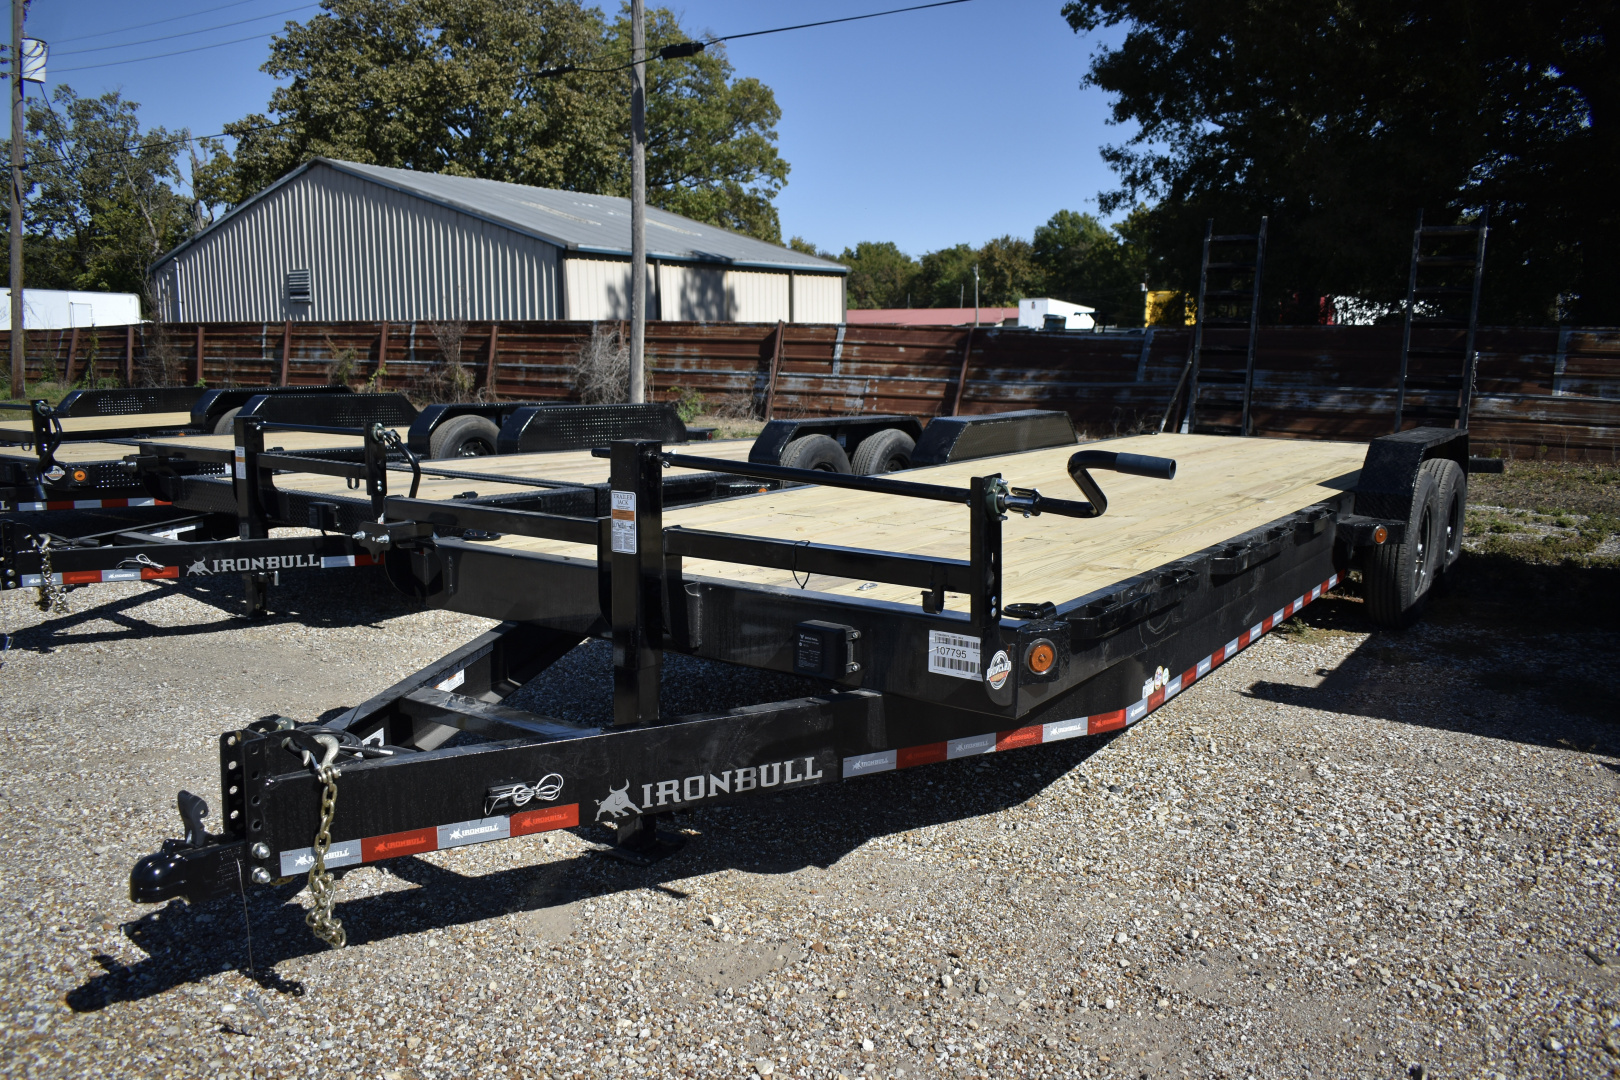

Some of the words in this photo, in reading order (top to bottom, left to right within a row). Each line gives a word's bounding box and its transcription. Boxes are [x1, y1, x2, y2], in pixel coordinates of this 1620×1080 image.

[212, 553, 320, 573] IRONBULL
[936, 646, 967, 659] 107795
[641, 756, 823, 809] IRONBULL
[461, 823, 499, 837] IRONBULL
[387, 837, 426, 849] IRONBULL
